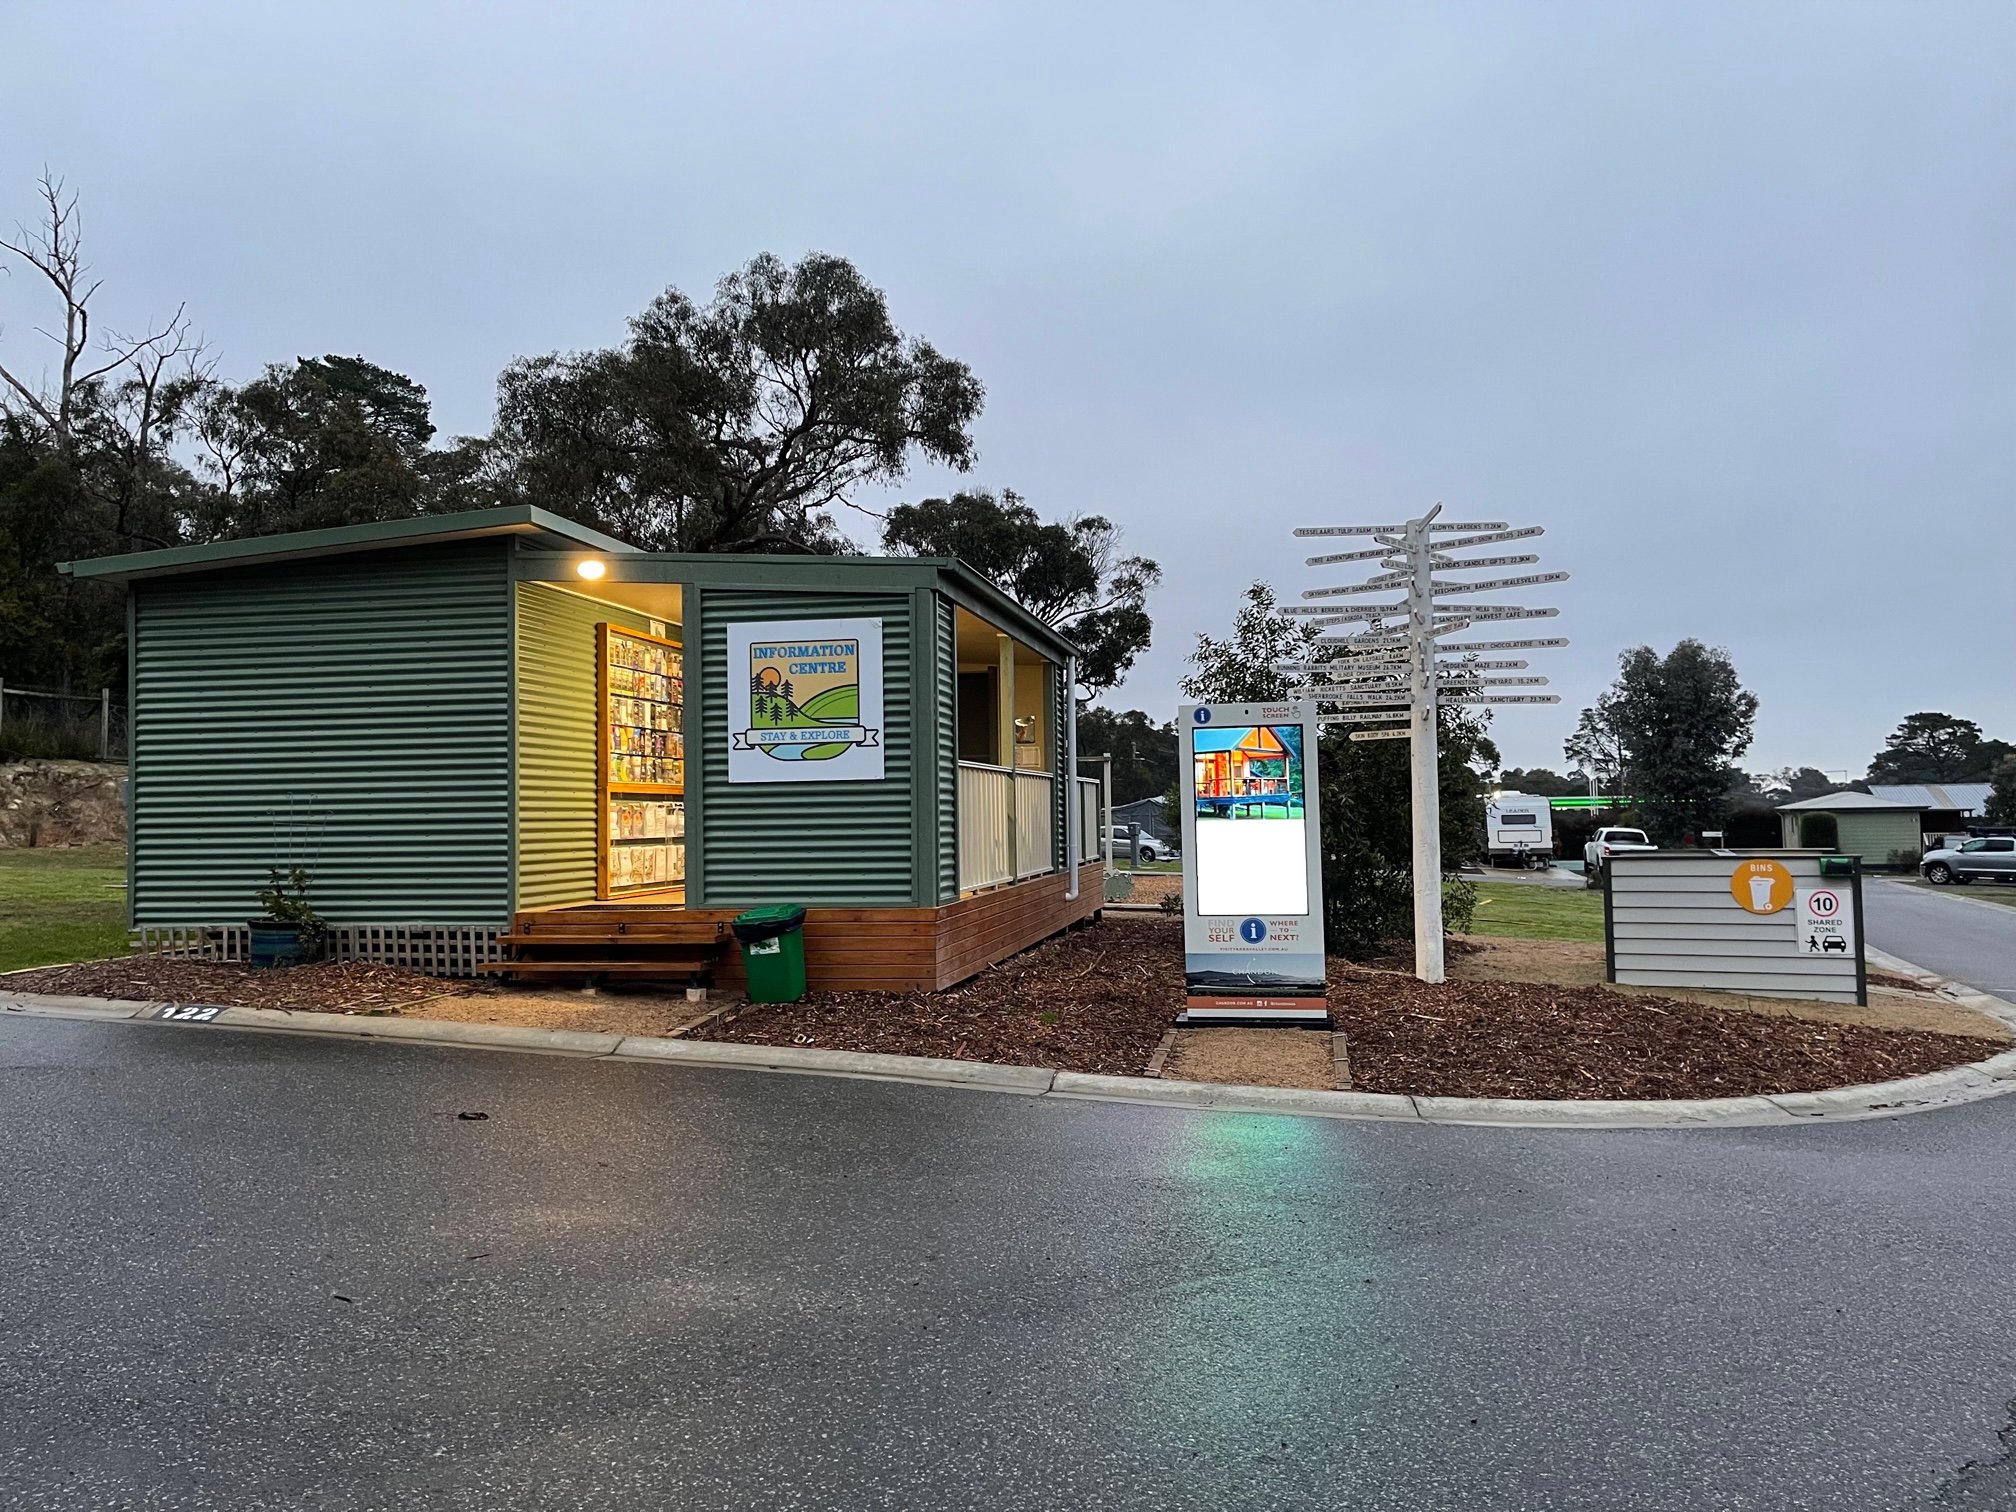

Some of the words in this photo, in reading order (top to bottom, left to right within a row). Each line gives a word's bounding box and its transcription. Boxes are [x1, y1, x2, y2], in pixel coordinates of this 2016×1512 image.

[1478, 535, 1493, 543] SNOW
[1495, 532, 1513, 540] FIELDS
[1326, 553, 1354, 562] ADVENTURE
[1360, 550, 1383, 558] BELGRAVE
[1463, 559, 1485, 567] CANDLE
[1352, 584, 1383, 593] DANDENONG
[1434, 585, 1470, 595] BEECHWORTH
[1475, 582, 1496, 590] BAKERY
[1502, 576, 1539, 586] HEALESVILLE
[1438, 615, 1471, 623] SANCTUARY
[753, 644, 855, 659] INFORMATION
[789, 661, 846, 675] CENTRE
[1317, 714, 1340, 722] PUFFING
[760, 731, 787, 742] STAY
[790, 731, 798, 741] &
[800, 729, 850, 741] EXPLORE
[1750, 863, 1773, 872] BINS
[1813, 897, 1833, 912] 10
[1207, 919, 1235, 927] FIND
[1208, 934, 1235, 942] SELF
[162, 1007, 219, 1021] 122
